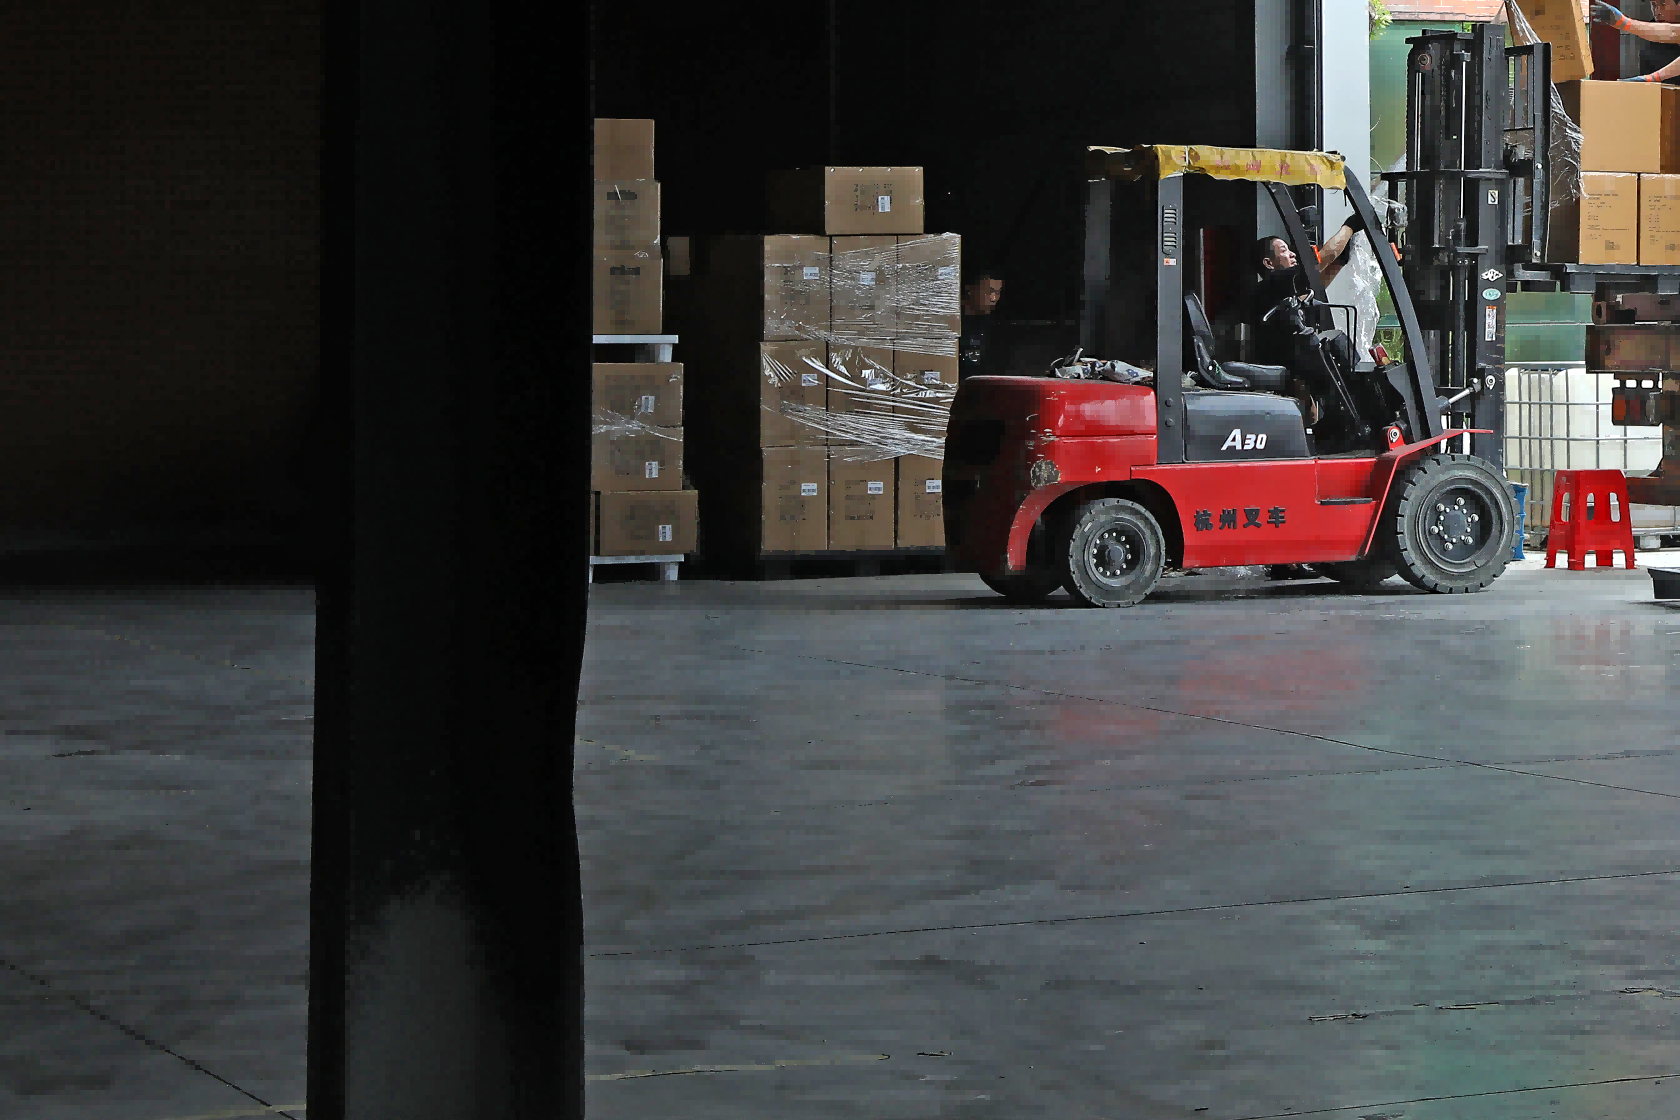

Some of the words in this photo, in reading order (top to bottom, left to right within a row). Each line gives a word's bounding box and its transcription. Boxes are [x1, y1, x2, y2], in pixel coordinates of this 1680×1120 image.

[1221, 428, 1268, 450] A30
[1193, 506, 1287, 531] 杭州叉车
